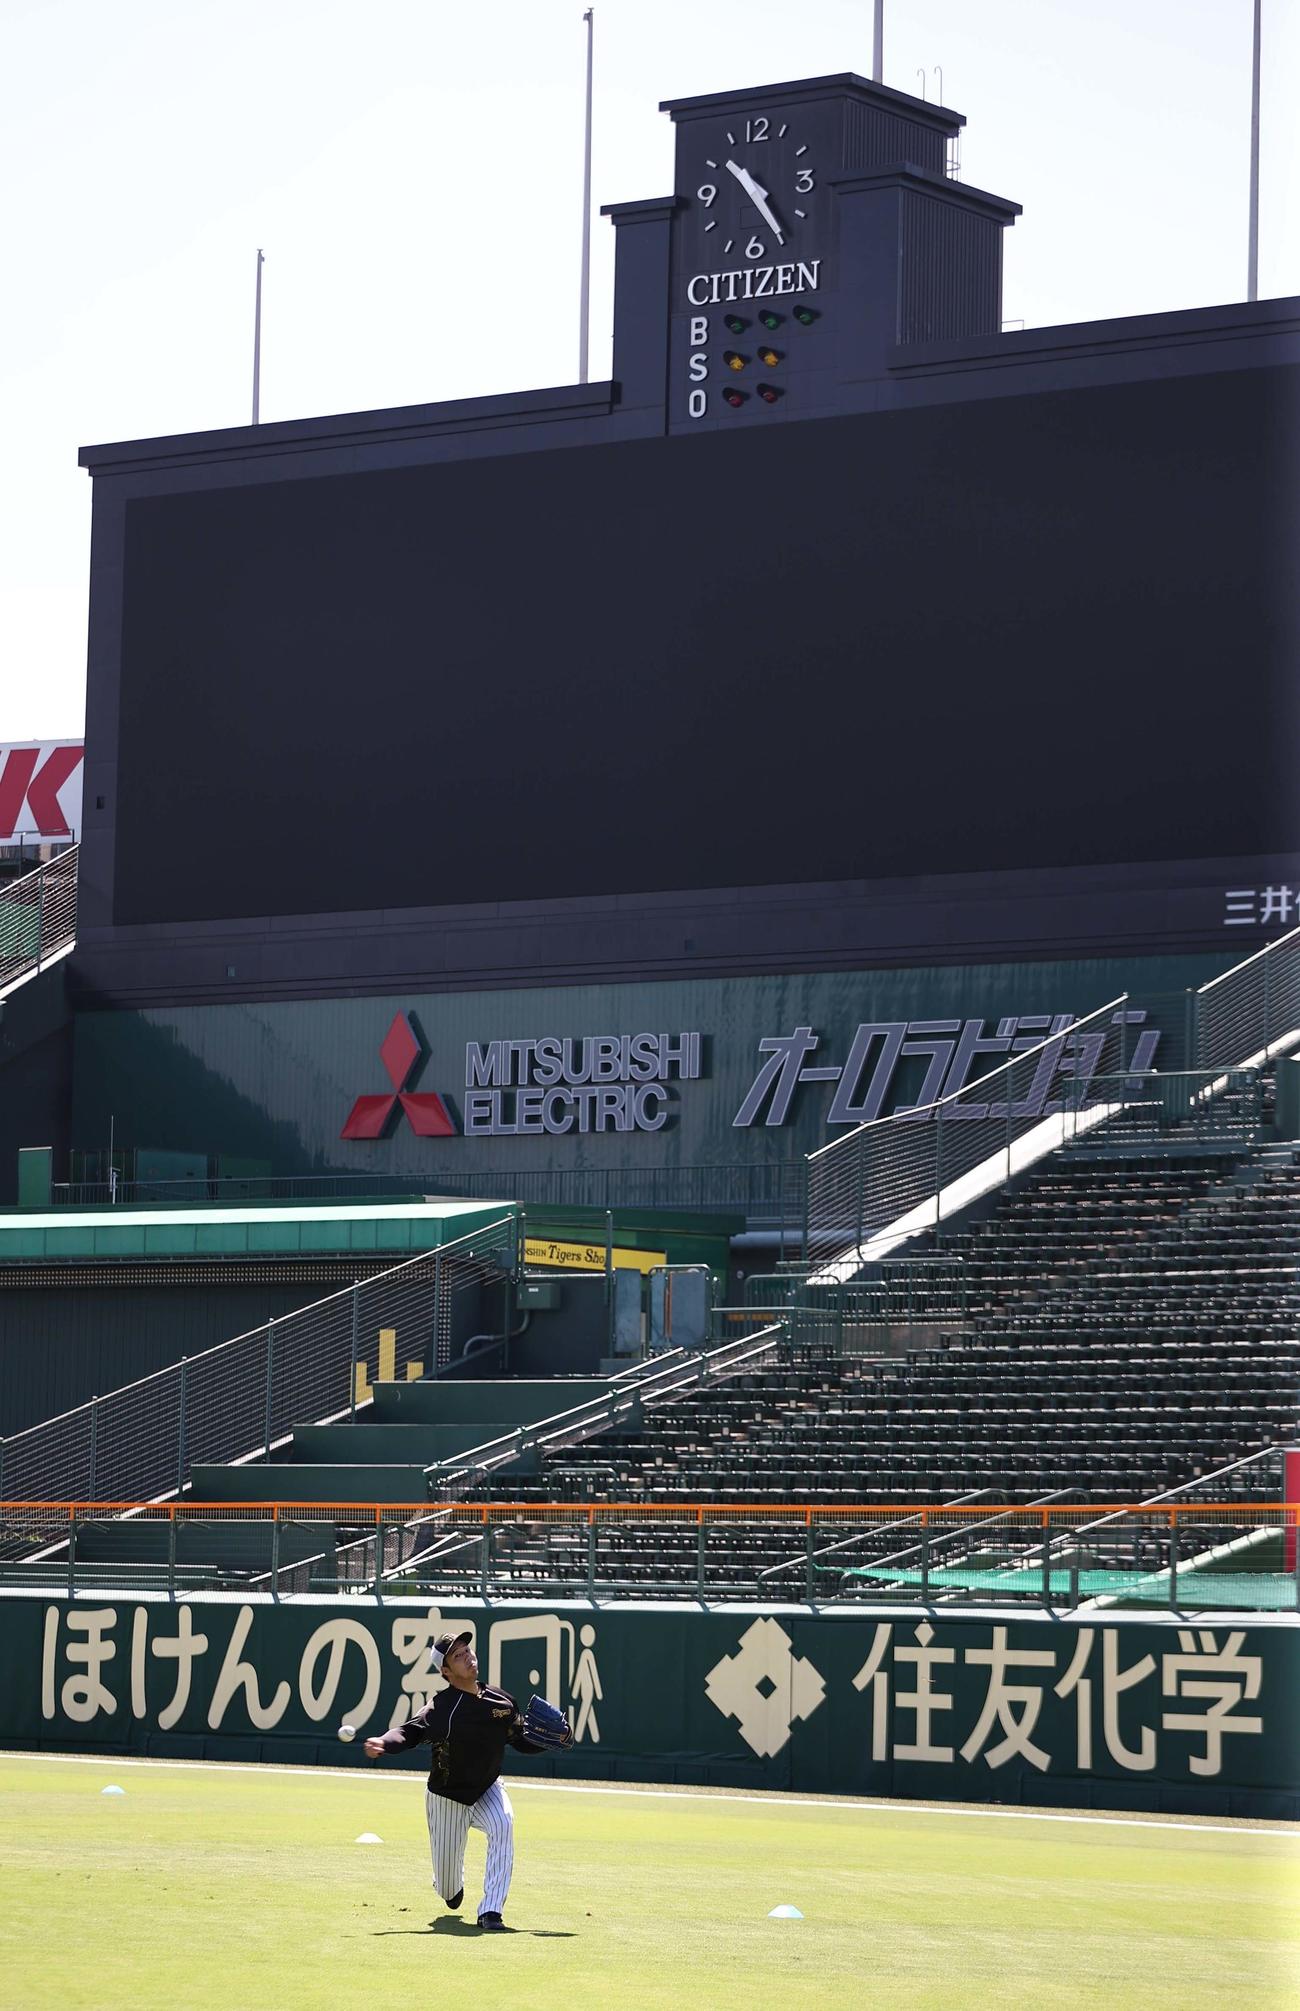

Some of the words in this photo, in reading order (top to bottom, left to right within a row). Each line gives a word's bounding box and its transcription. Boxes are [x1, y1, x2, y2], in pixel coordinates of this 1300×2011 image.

[746, 118, 769, 143] 12
[795, 169, 814, 193] 3
[697, 184, 716, 208] 9
[745, 236, 764, 259] 6
[687, 260, 820, 306] CITIZEN
[690, 316, 708, 346] B
[689, 353, 708, 381] S
[689, 389, 707, 418] O
[465, 1032, 700, 1087] MITSUBISHI
[464, 1083, 668, 1137] ELECTRIC
[548, 1244, 582, 1264] Tigers
[584, 1248, 606, 1265] Sho
[852, 1618, 1264, 1776] 住友化学
